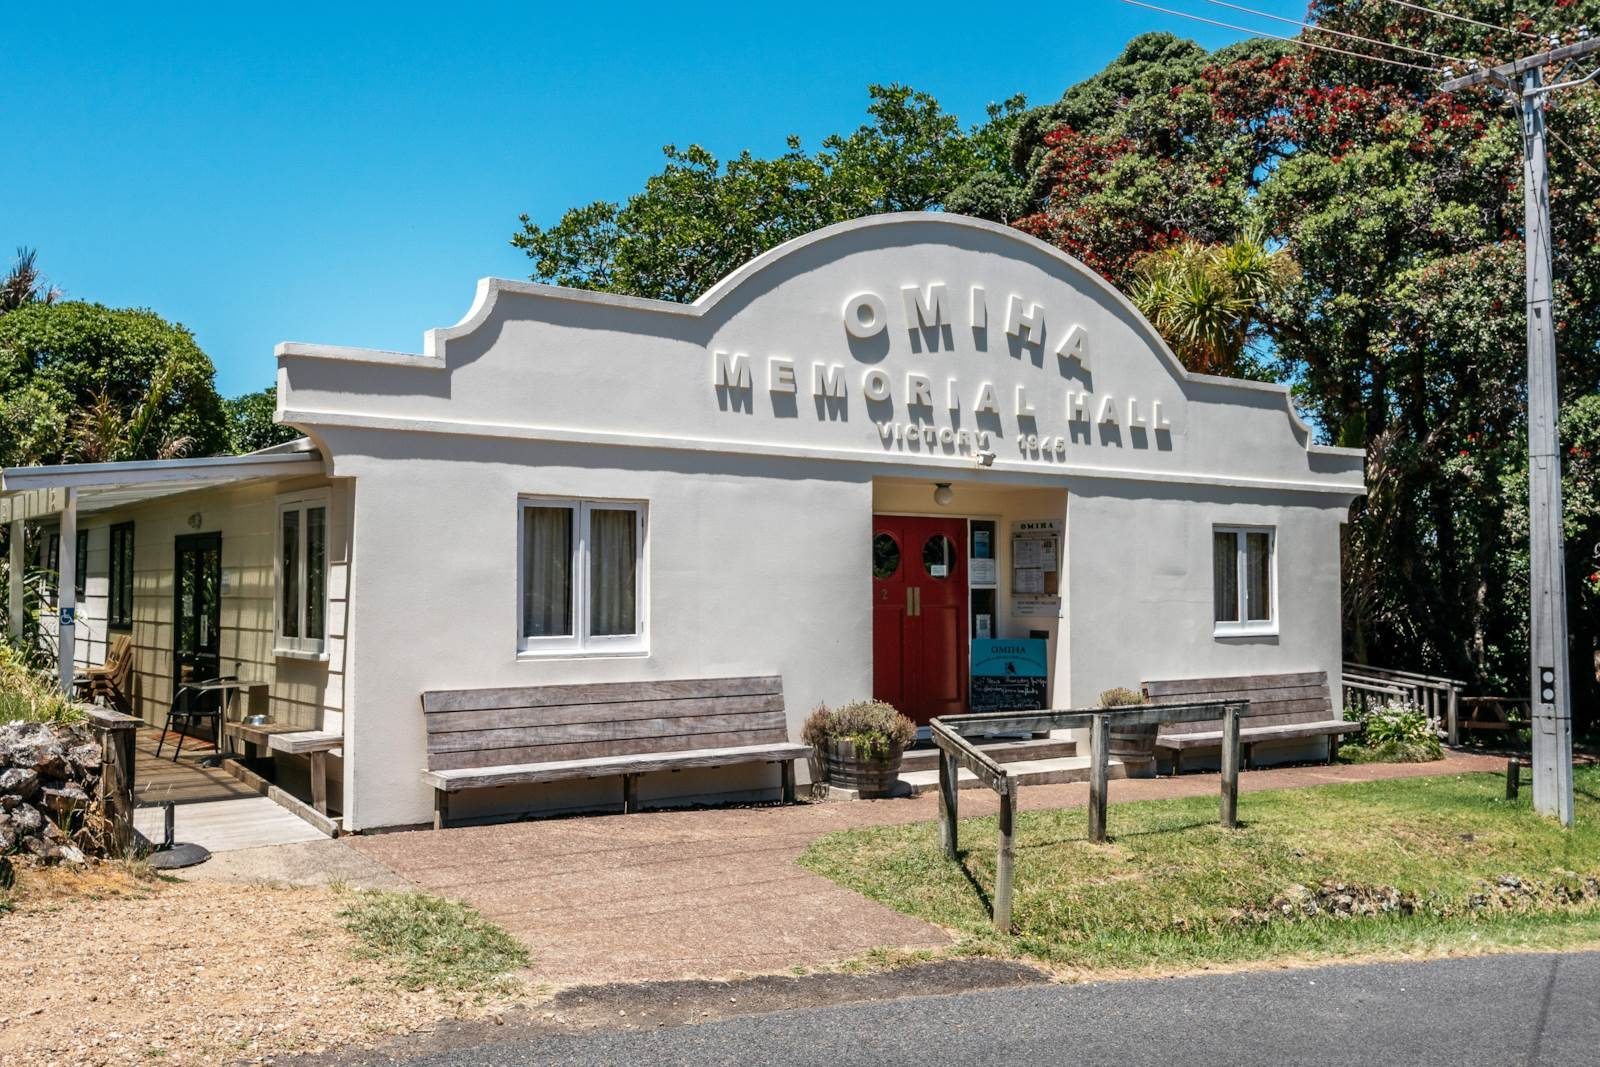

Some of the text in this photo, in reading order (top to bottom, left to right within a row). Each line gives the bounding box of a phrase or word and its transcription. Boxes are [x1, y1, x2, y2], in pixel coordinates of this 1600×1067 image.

[842, 283, 1092, 372] OMIHA
[713, 350, 1171, 431] MEMORIAL HALL
[876, 421, 1066, 453] VICTORY 1945
[1020, 522, 1054, 530] OMIHA
